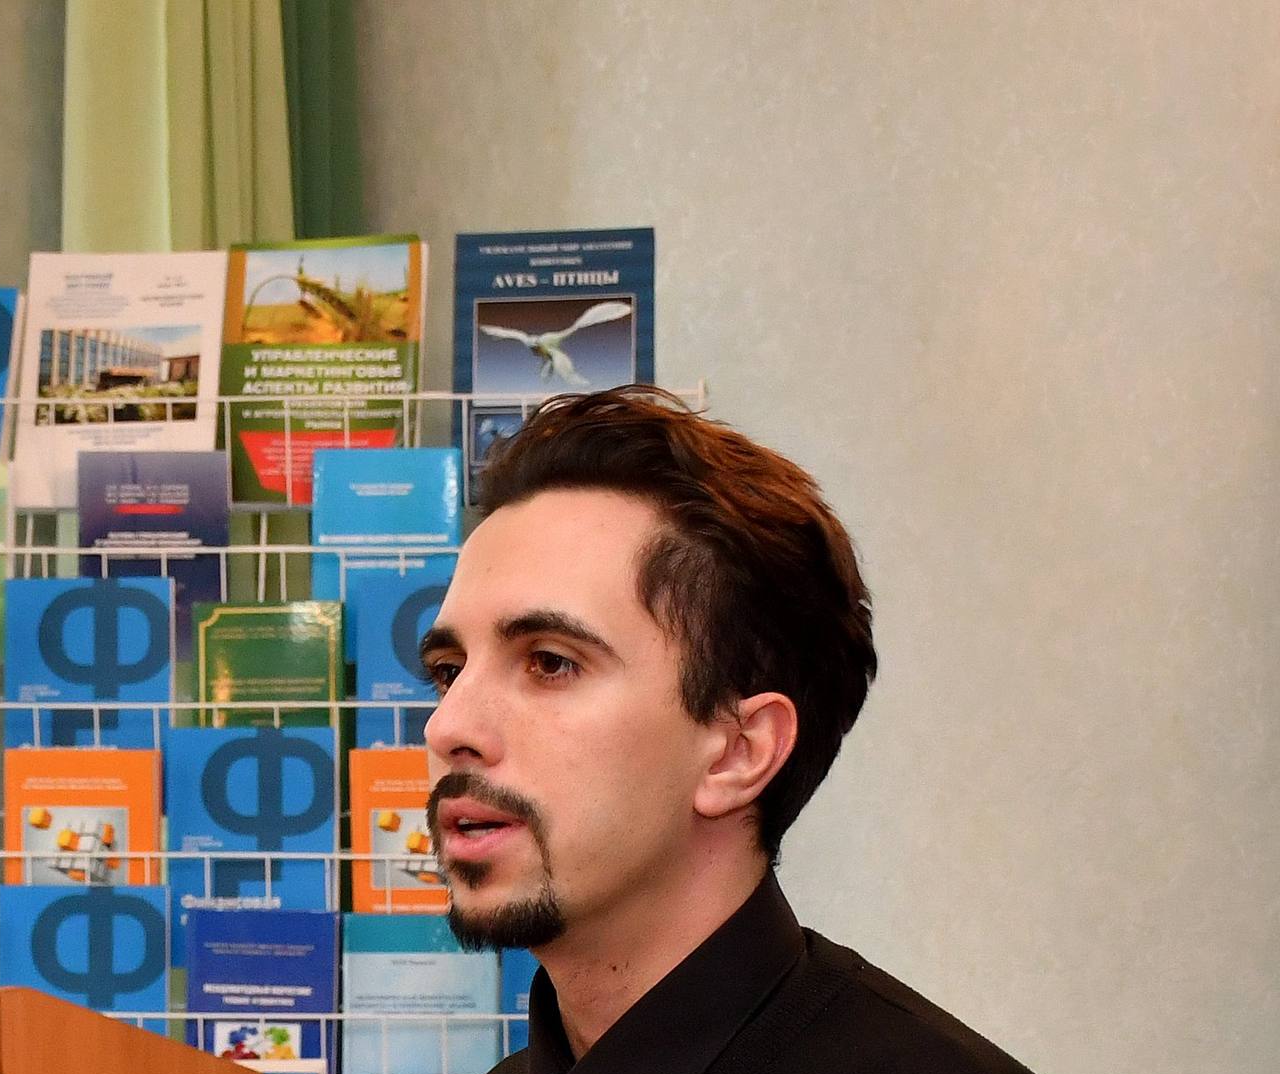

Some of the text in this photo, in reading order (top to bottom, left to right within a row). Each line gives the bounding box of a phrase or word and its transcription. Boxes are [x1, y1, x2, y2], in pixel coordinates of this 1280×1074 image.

[493, 272, 537, 289] AVES
[553, 269, 619, 287] ПТИЦЫ
[251, 348, 398, 362] УПРАВЛЕНЧЕСКИЕ
[244, 363, 402, 378] И МАРКЕТИНГОВЫЕ
[242, 380, 411, 395] АСПЕКТЫ РАЗВИТИЯ
